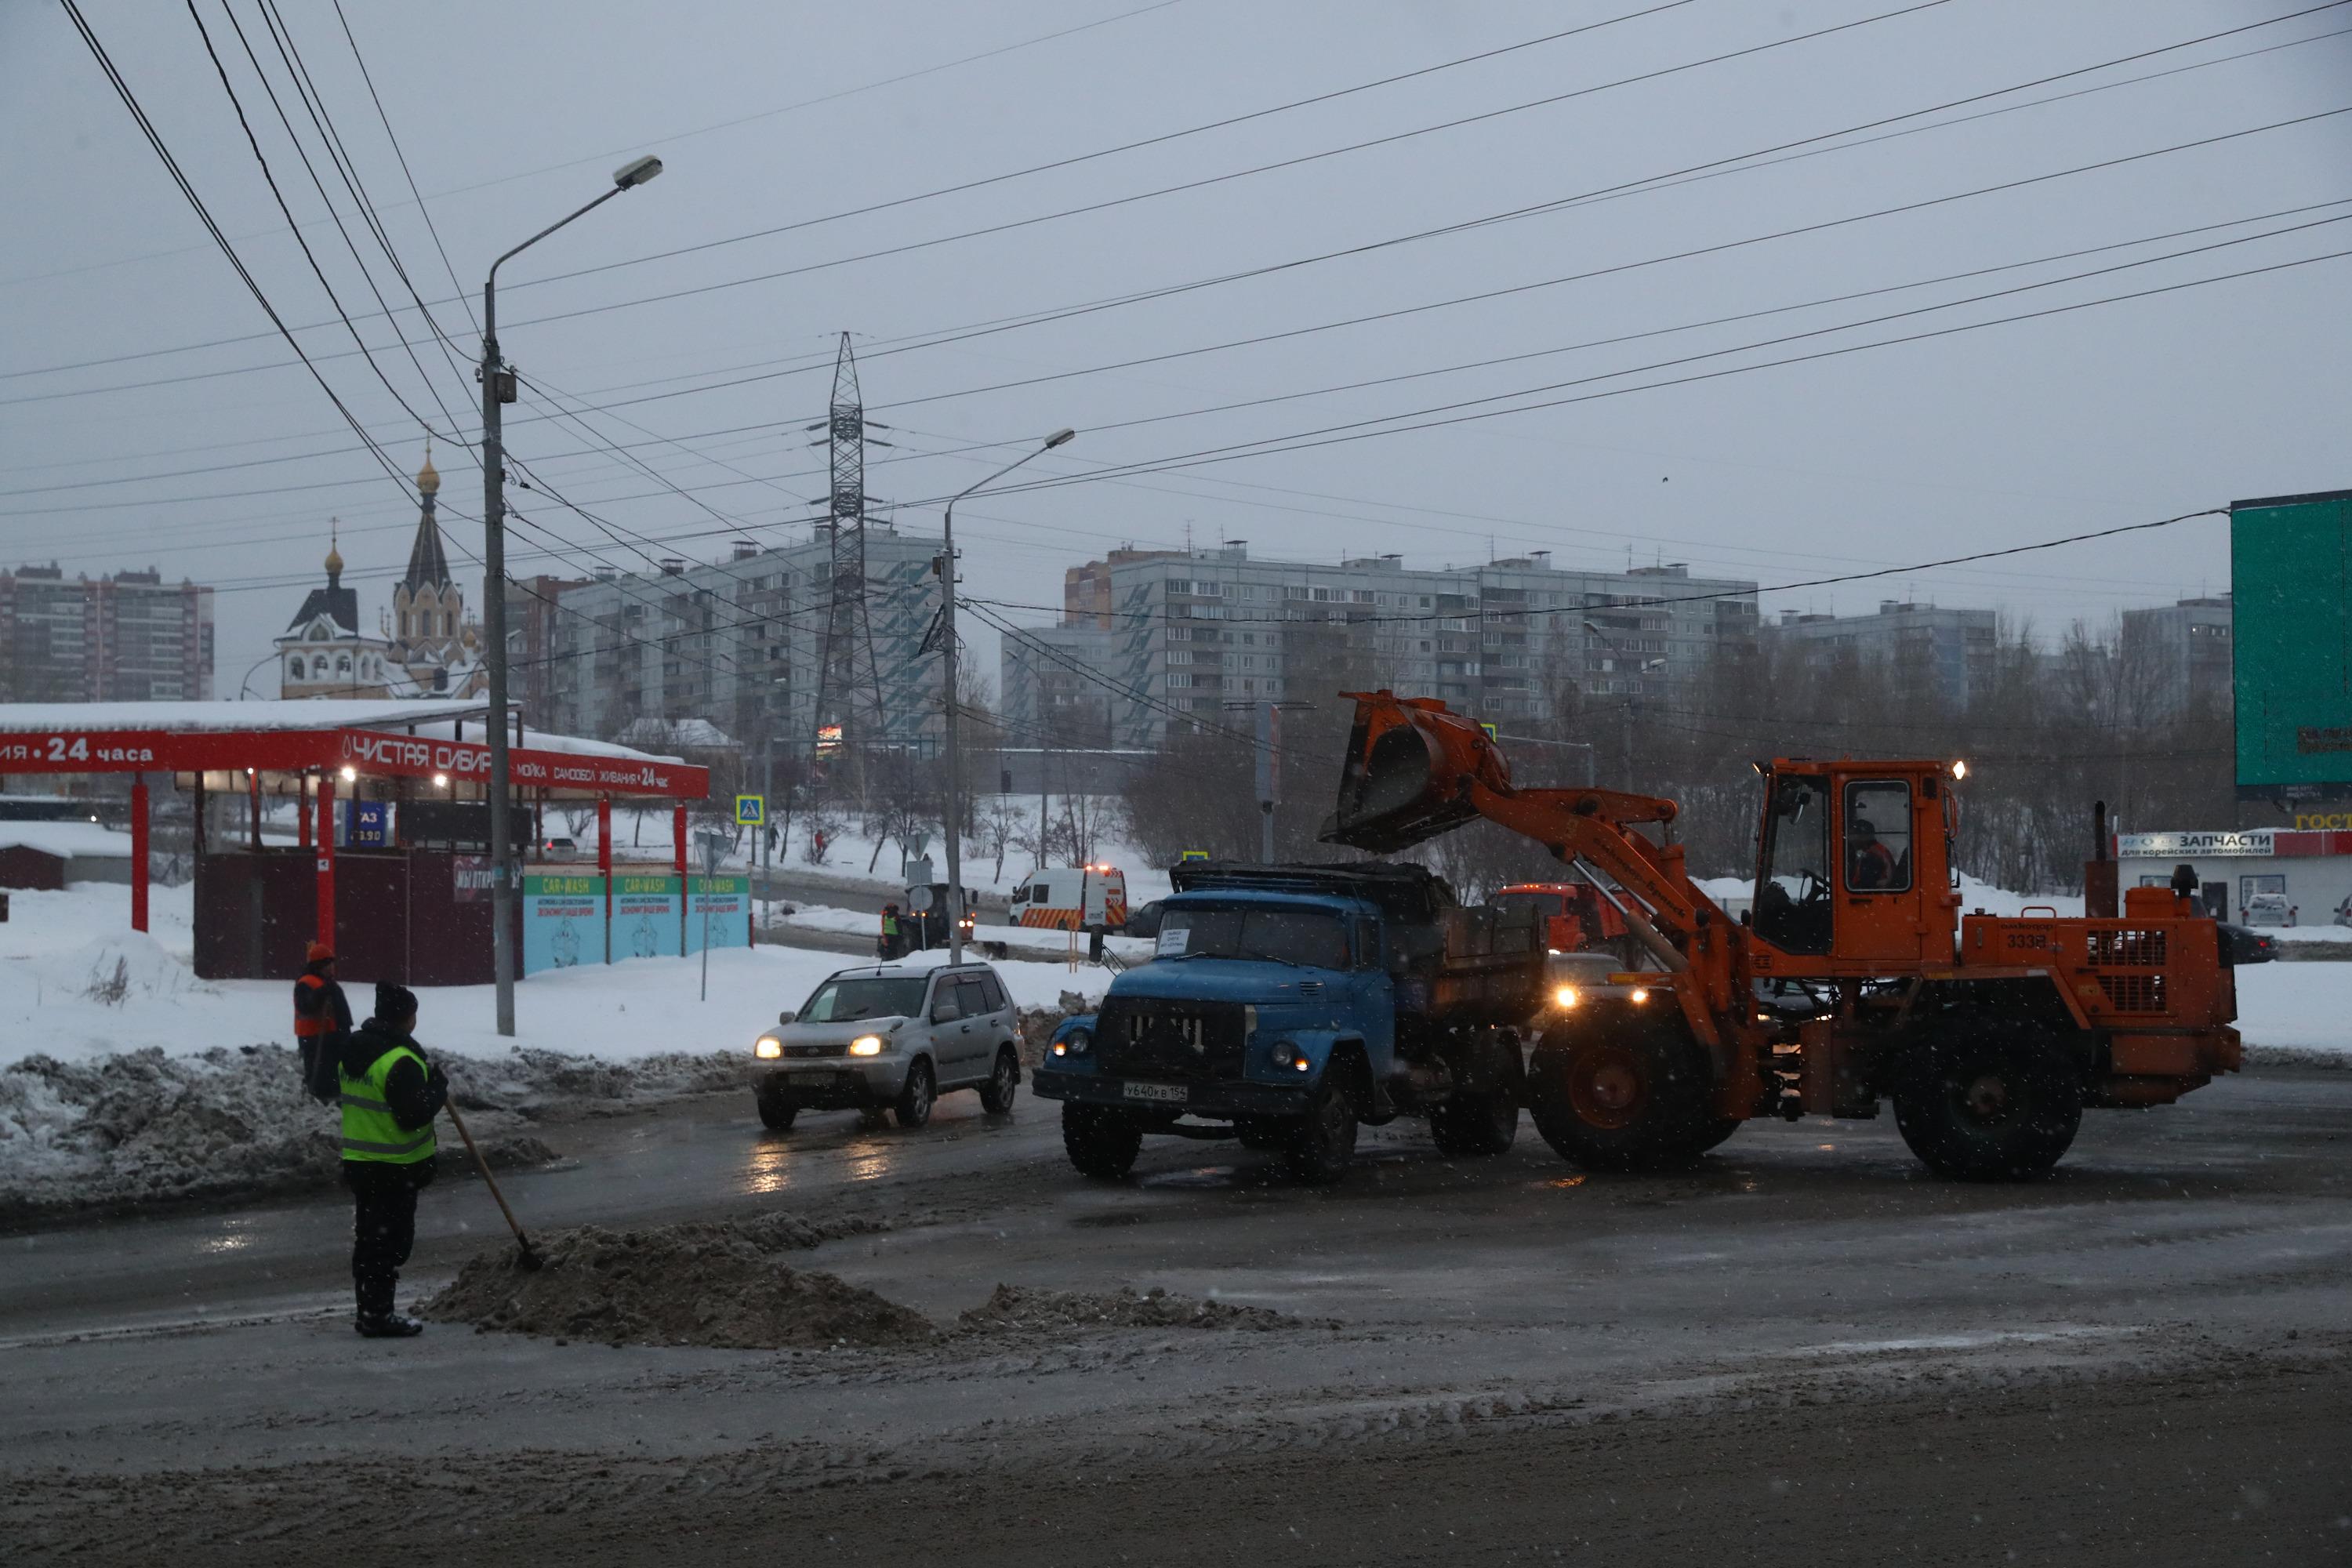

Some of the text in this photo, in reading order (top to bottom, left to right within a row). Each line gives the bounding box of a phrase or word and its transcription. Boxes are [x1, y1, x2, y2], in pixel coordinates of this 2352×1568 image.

[47, 737, 89, 761] 24
[96, 748, 154, 761] часа
[353, 735, 492, 773] ЧИСТАЯ СИБИР
[642, 768, 655, 786] 24
[2180, 835, 2270, 847] ЗАПЧАСТИ
[2143, 848, 2198, 858] корейских
[2200, 847, 2271, 855] автомобилей
